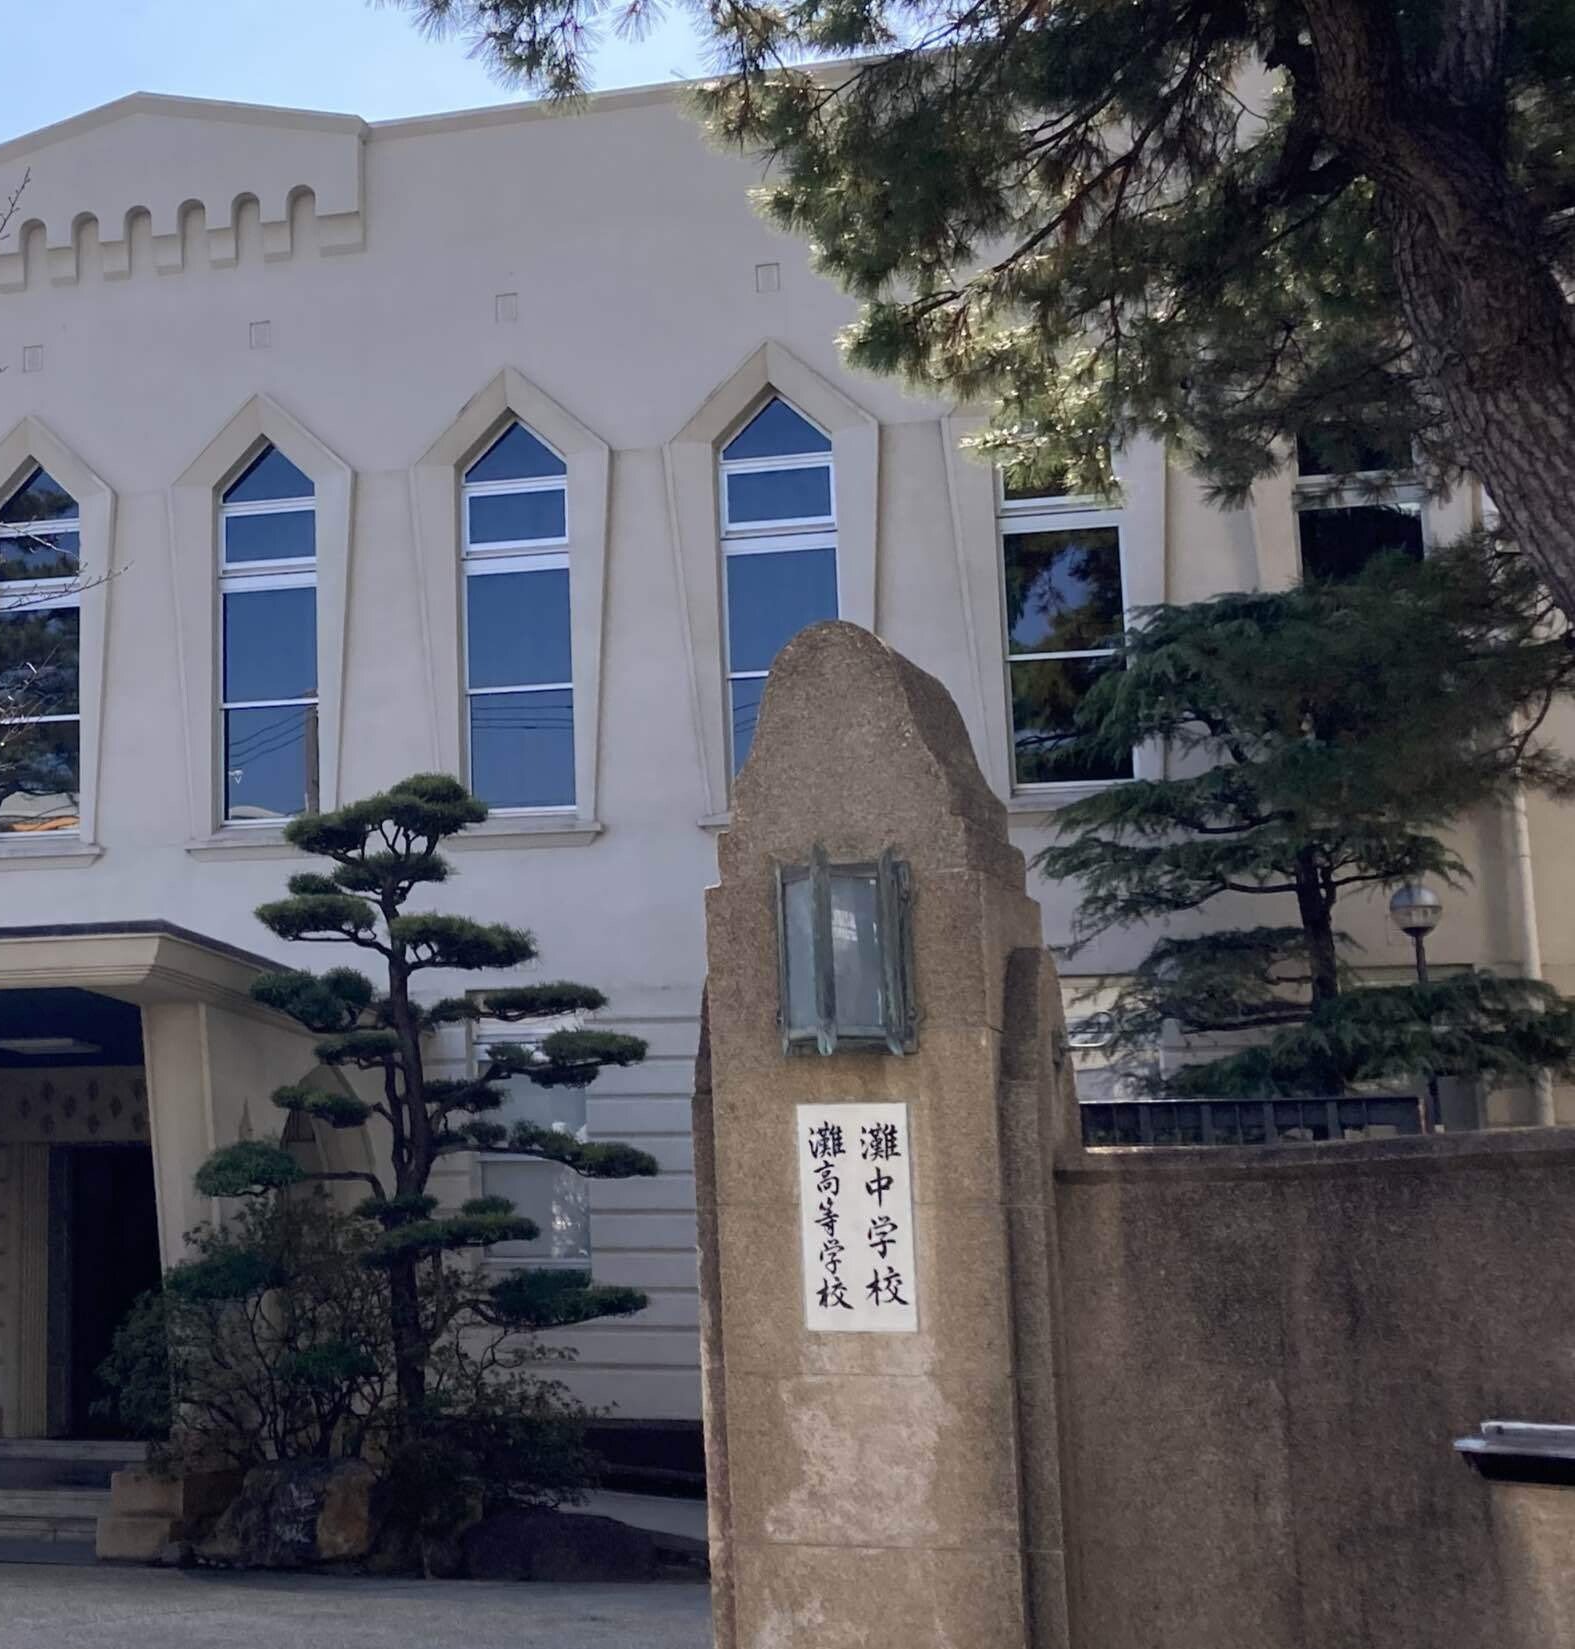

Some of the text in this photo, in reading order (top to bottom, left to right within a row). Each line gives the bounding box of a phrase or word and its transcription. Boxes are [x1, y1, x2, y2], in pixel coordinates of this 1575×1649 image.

[808, 1121, 854, 1309] 灘高等学校
[860, 1122, 910, 1306] 灘中学校
